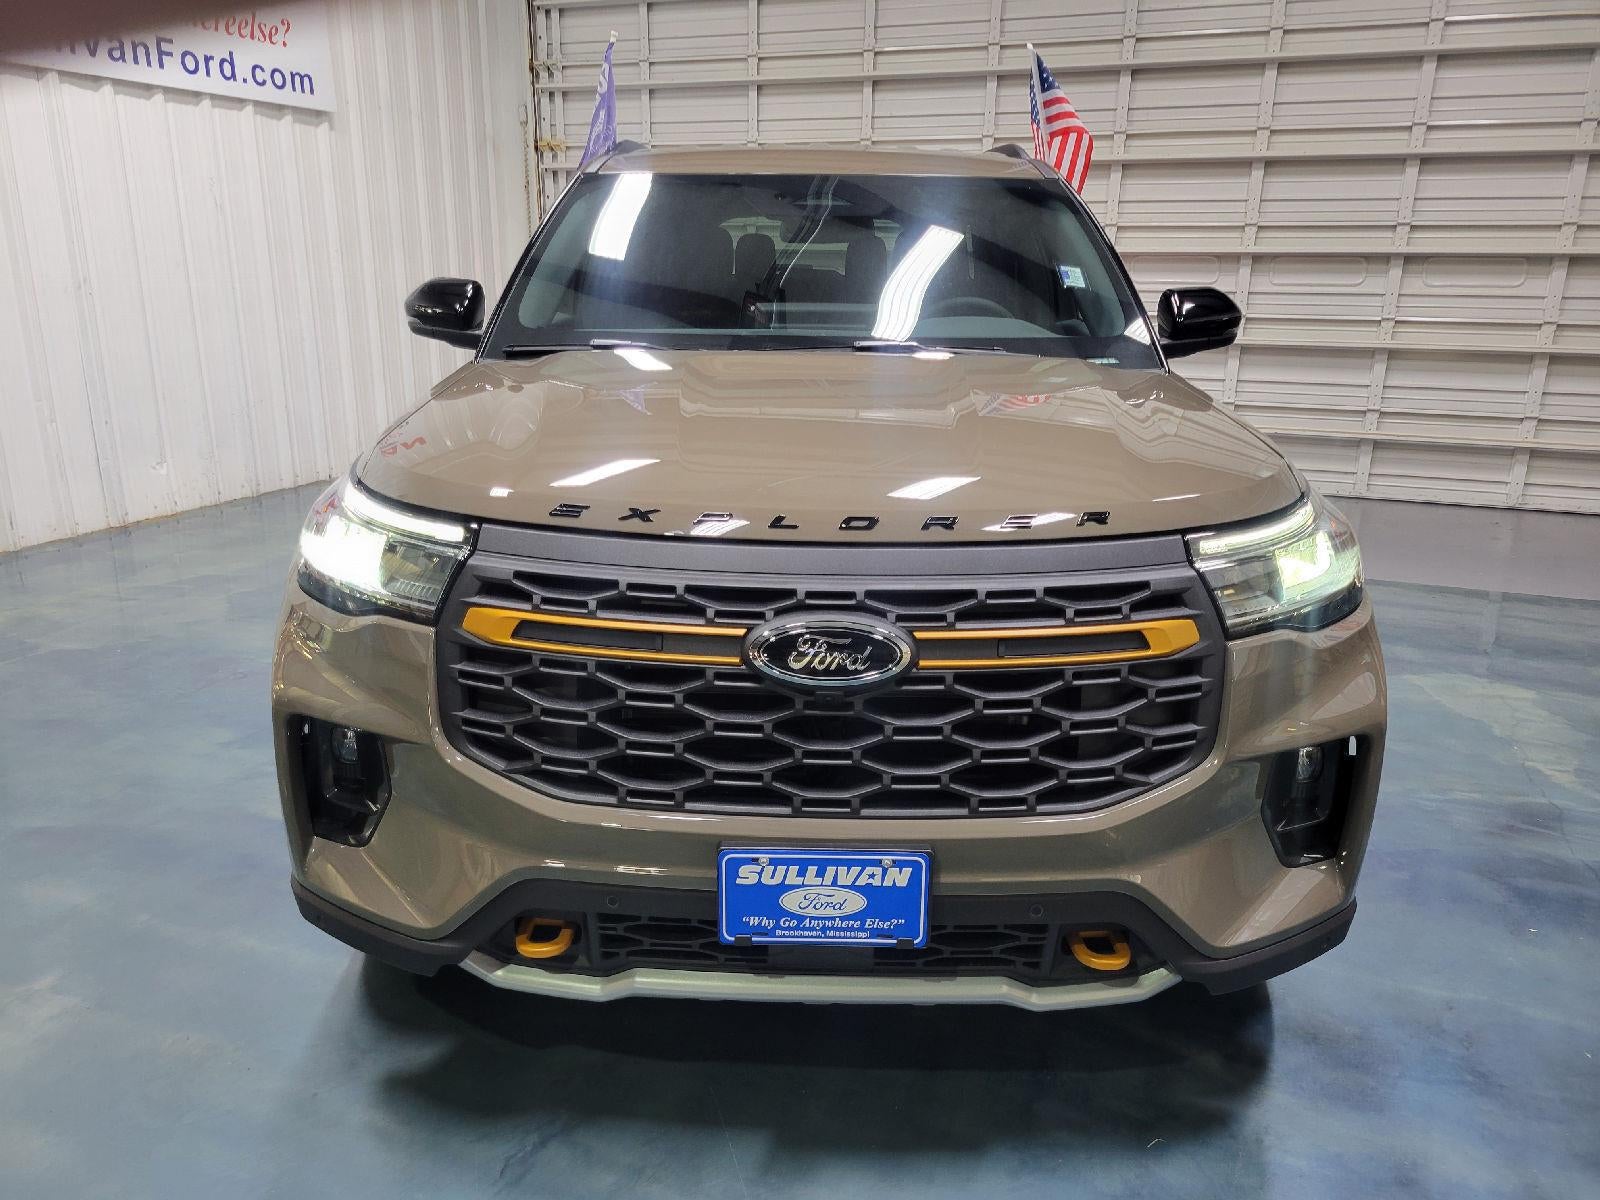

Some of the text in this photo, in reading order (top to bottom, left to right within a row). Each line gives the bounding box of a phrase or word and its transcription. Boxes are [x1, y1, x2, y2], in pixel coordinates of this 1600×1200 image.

[548, 503, 1112, 530] EXPLORER
[788, 634, 870, 671] Ford
[735, 865, 913, 887] SULLIVAN
[797, 892, 848, 912] Ford
[780, 917, 798, 928] Go
[800, 918, 861, 929] Anywhere
[775, 929, 870, 939] Brookhaven, Mississippi
